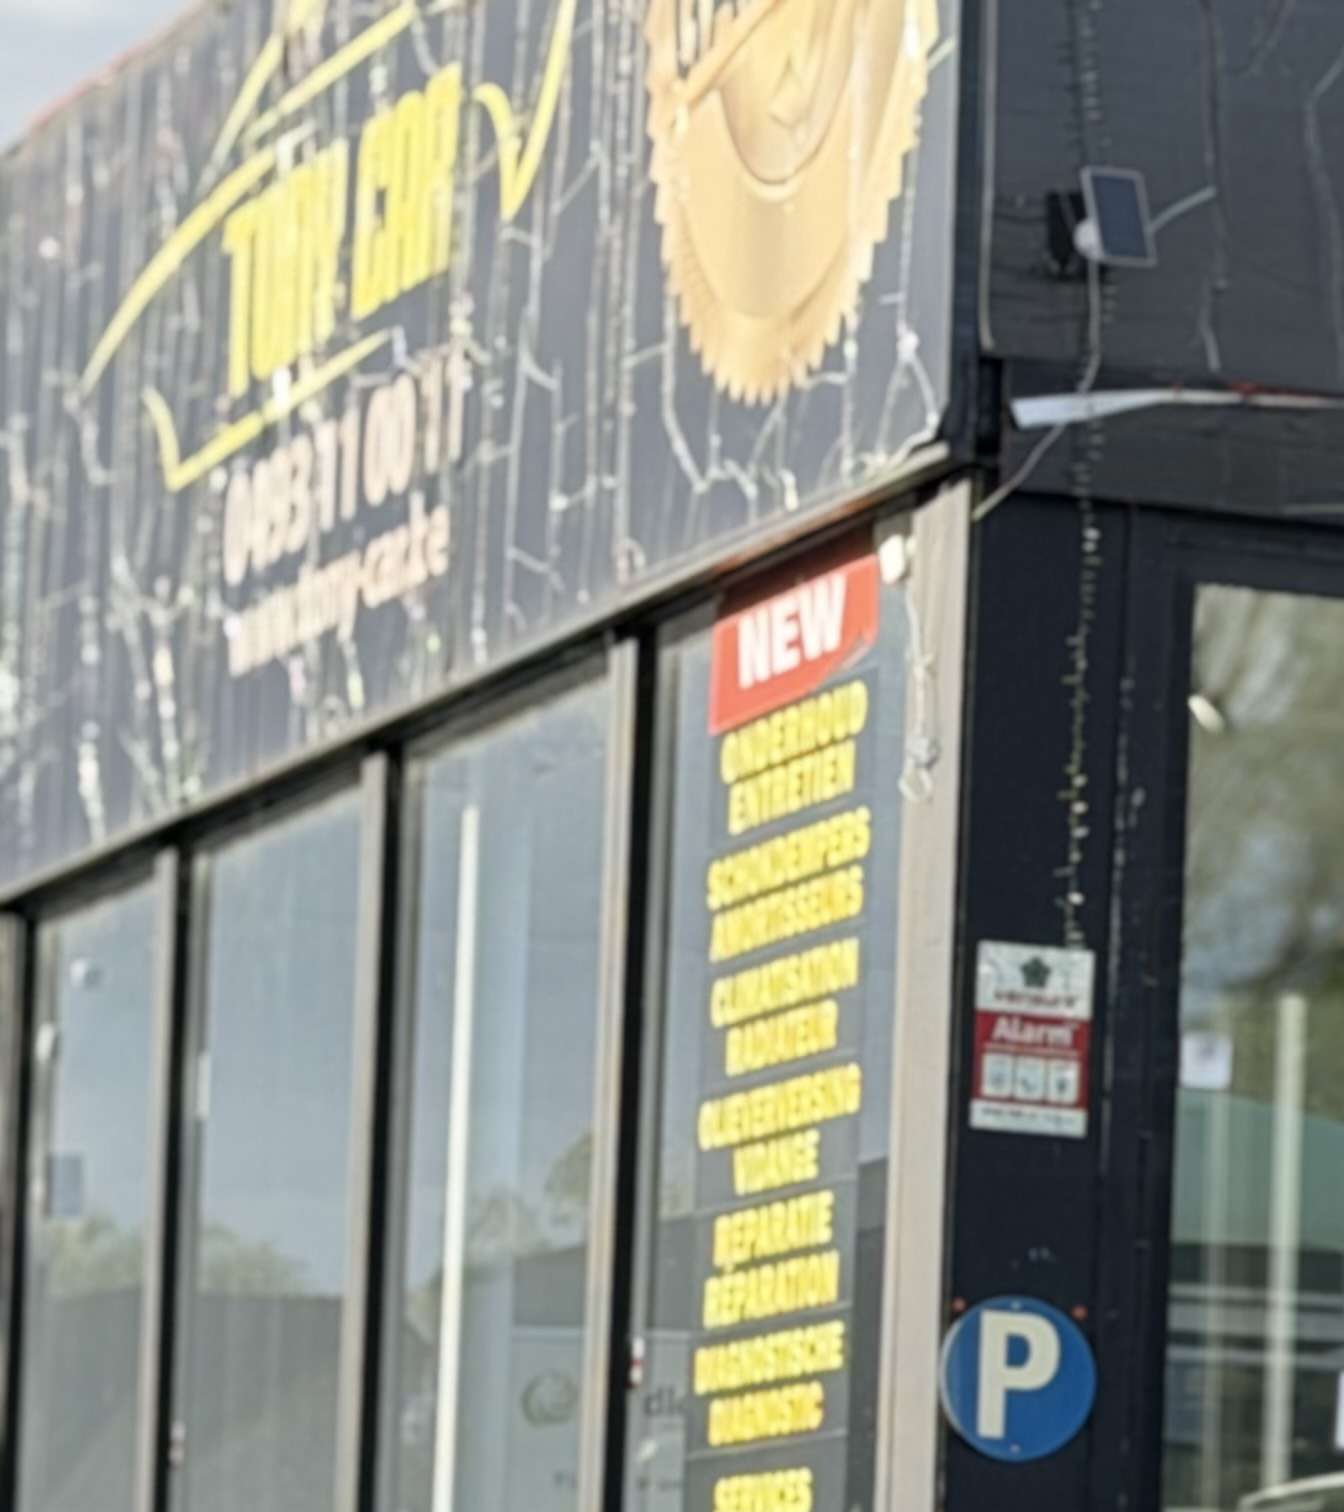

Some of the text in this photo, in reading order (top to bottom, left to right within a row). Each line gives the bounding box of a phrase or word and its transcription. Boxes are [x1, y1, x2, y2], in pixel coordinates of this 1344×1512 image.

[350, 62, 463, 320] CAR
[736, 574, 848, 691] NEW
[730, 740, 853, 833] ENTRETIEN
[714, 1190, 832, 1267] REPARATIE
[977, 1310, 1060, 1438] P
